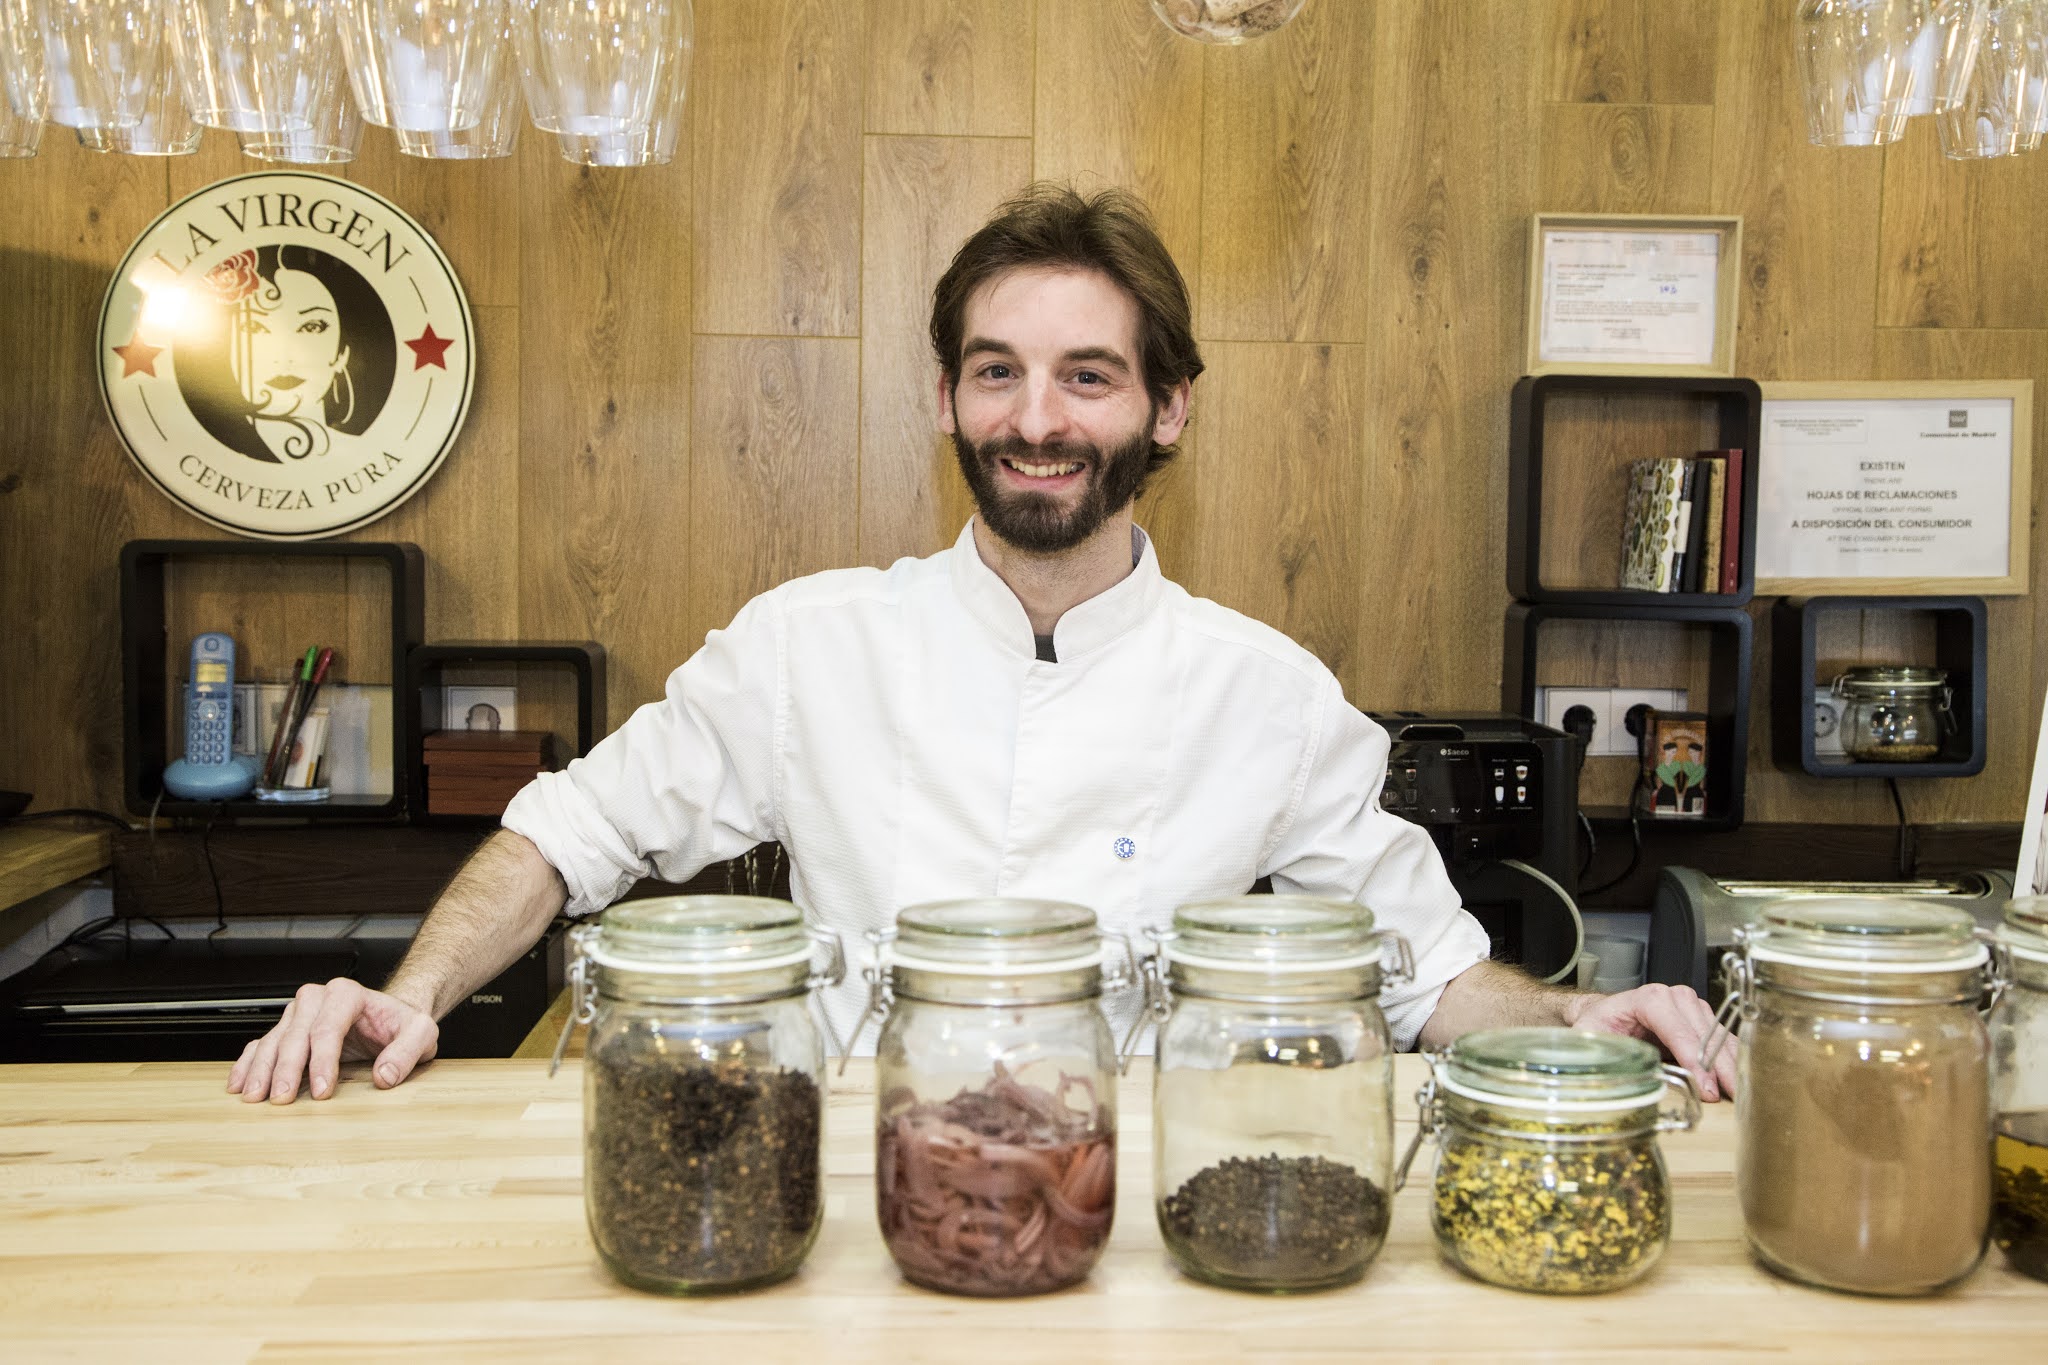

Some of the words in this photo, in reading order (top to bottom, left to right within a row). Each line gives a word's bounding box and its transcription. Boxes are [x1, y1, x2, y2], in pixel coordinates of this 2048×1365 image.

[151, 221, 220, 276] LA
[216, 193, 413, 274] VIRGEN
[1860, 461, 1905, 471] EXISTEN
[178, 453, 314, 511] CERVEZA
[323, 450, 404, 503] PURA
[1807, 490, 1844, 500] HOJAS
[1846, 490, 1861, 499] DE
[1864, 490, 1958, 499] RECLAMACIONES
[1791, 519, 1800, 528] A
[1802, 518, 1870, 528] DISPOSICIÓN
[1874, 519, 1894, 528] DEL
[1898, 519, 1972, 528] CONSUMIDOR
[1447, 748, 1470, 756] Saeco
[471, 995, 503, 1004] EPSON
